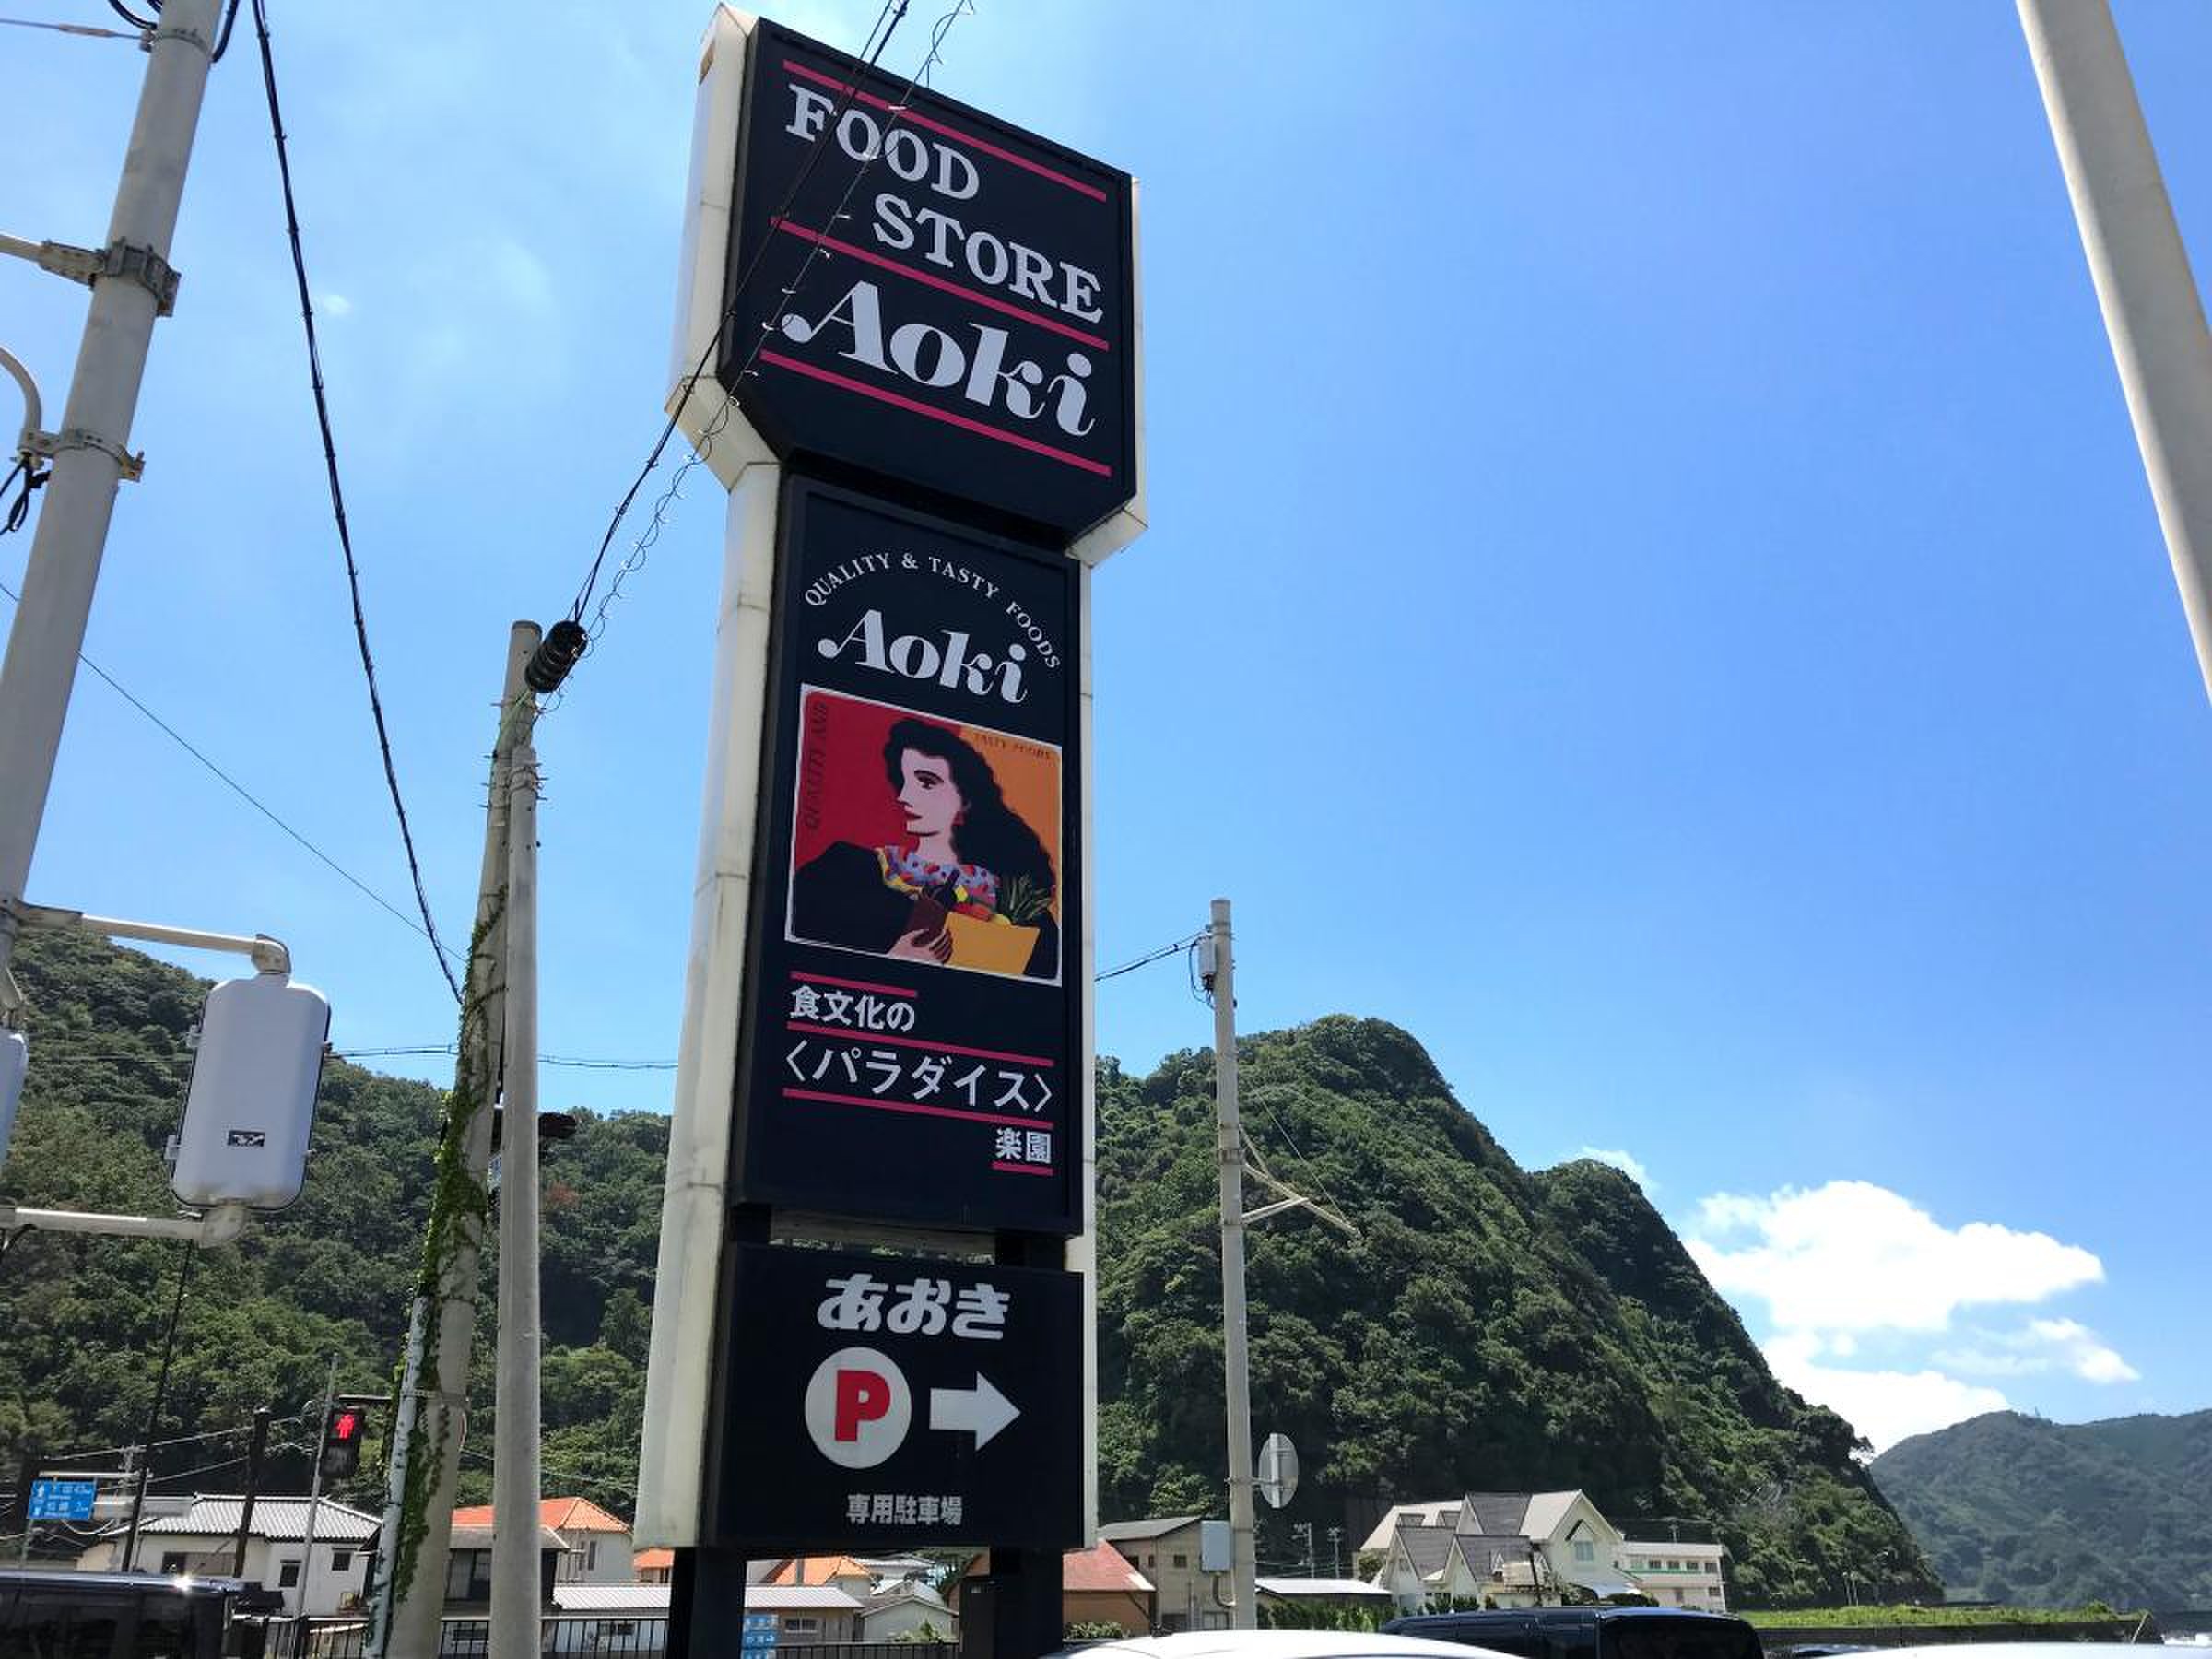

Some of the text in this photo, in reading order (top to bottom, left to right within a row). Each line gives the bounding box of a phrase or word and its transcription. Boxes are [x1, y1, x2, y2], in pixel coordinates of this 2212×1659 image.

[785, 82, 980, 200] FOOD
[872, 192, 1104, 324] STORE
[782, 280, 1096, 437] Aoki
[805, 553, 1061, 670] QUALITY & TASTY FOODS
[818, 608, 1029, 705] Aoki
[790, 984, 916, 1032] 食文化の
[995, 1127, 1053, 1165] 楽園
[817, 1273, 1012, 1341] あおき
[834, 1369, 891, 1442] P
[846, 1493, 963, 1526] 専用駐車場
